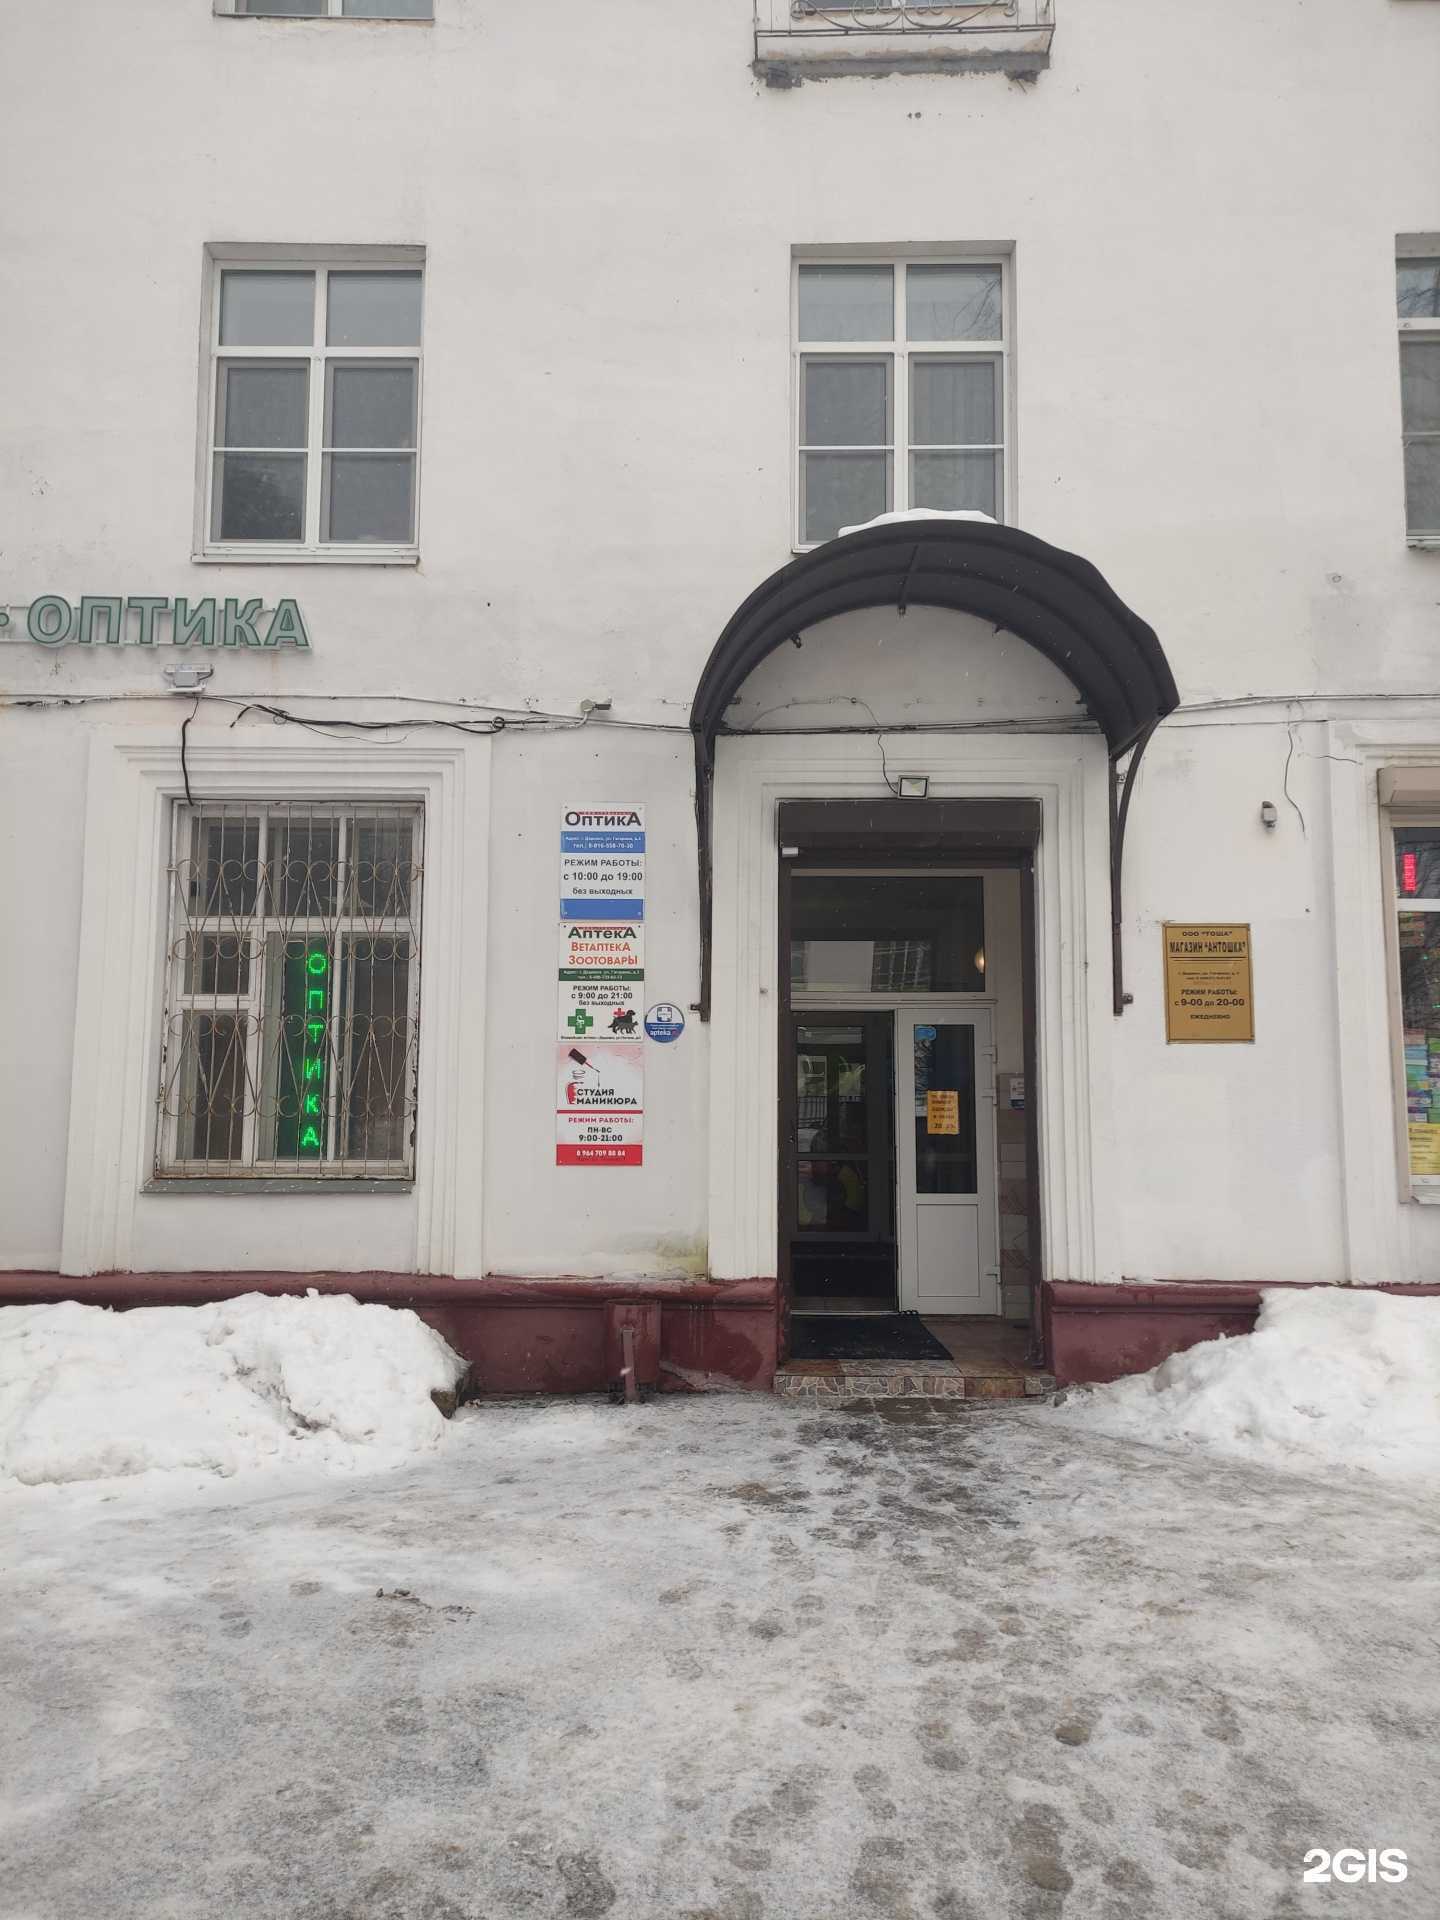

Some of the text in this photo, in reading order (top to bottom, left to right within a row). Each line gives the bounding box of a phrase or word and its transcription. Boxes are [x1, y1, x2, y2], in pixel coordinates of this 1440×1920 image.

[27, 595, 311, 648] ОПТИКА
[564, 859, 642, 867] РЕЖИМ РАБОТЫ:
[573, 872, 598, 881] 10:00
[600, 873, 614, 882] до
[617, 872, 643, 881] 19:00
[572, 887, 633, 896] без выходных
[1169, 941, 1203, 953] МАГАЗИН
[1181, 998, 1203, 1006] 9-00
[1216, 998, 1245, 1006] 20-00
[301, 953, 328, 1147] ОПТИКА
[577, 1088, 614, 1096] СТУДИЯ
[577, 1097, 637, 1105] МАНИКЮРА
